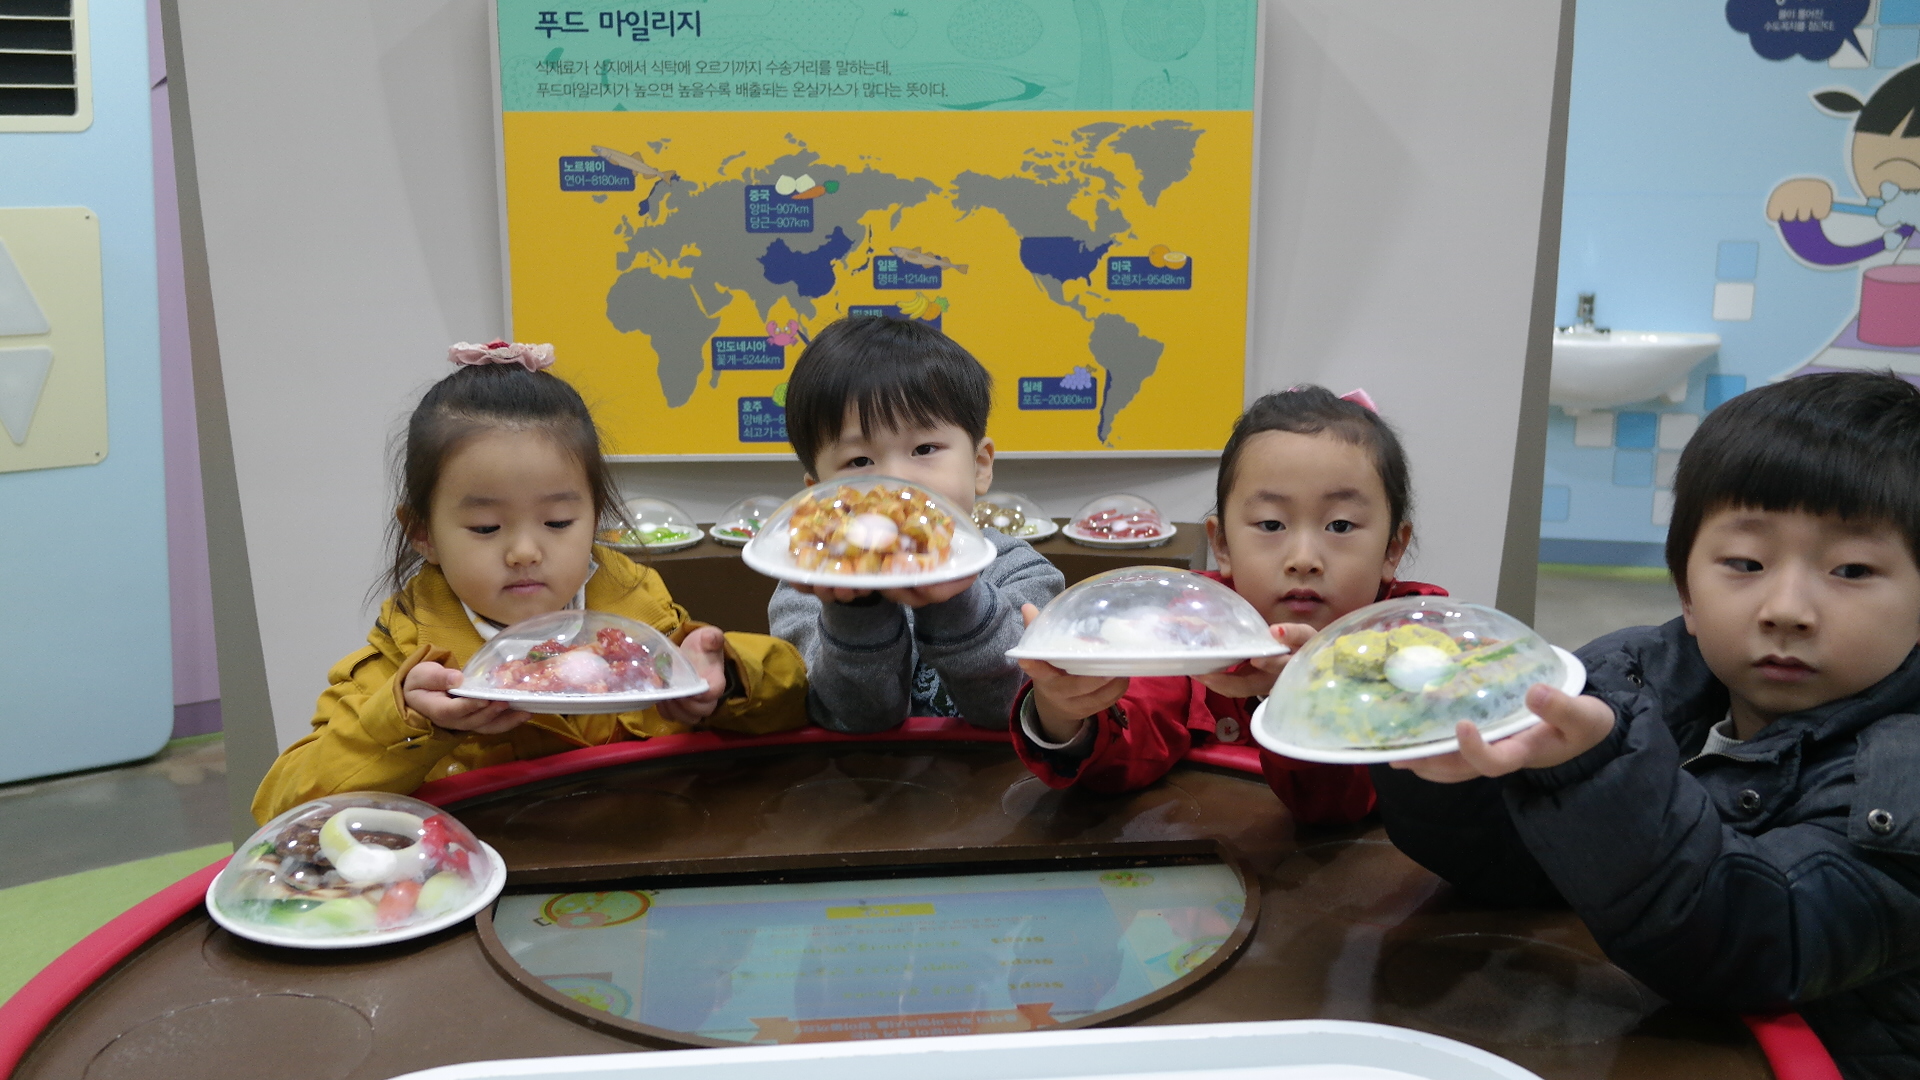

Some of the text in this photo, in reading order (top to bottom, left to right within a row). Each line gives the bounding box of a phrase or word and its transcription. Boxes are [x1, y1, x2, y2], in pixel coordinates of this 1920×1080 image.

[535, 10, 701, 41] 푸드 마일리지
[535, 59, 892, 76] 식재료가 산지에서 식탁에 오르기까지 수송거리를 말하는데,
[536, 81, 949, 98] 푸드마일리지가 높으면 높을수록 배출되는 온실가스가 많다는 뜻이다.
[564, 161, 605, 173] 노르웨이
[749, 189, 770, 202] 중국
[877, 259, 898, 272] 일본
[1111, 260, 1131, 273] 미국
[716, 340, 767, 353] 인도네시아
[1023, 380, 1043, 393] 칠레
[742, 400, 763, 413] 호주
